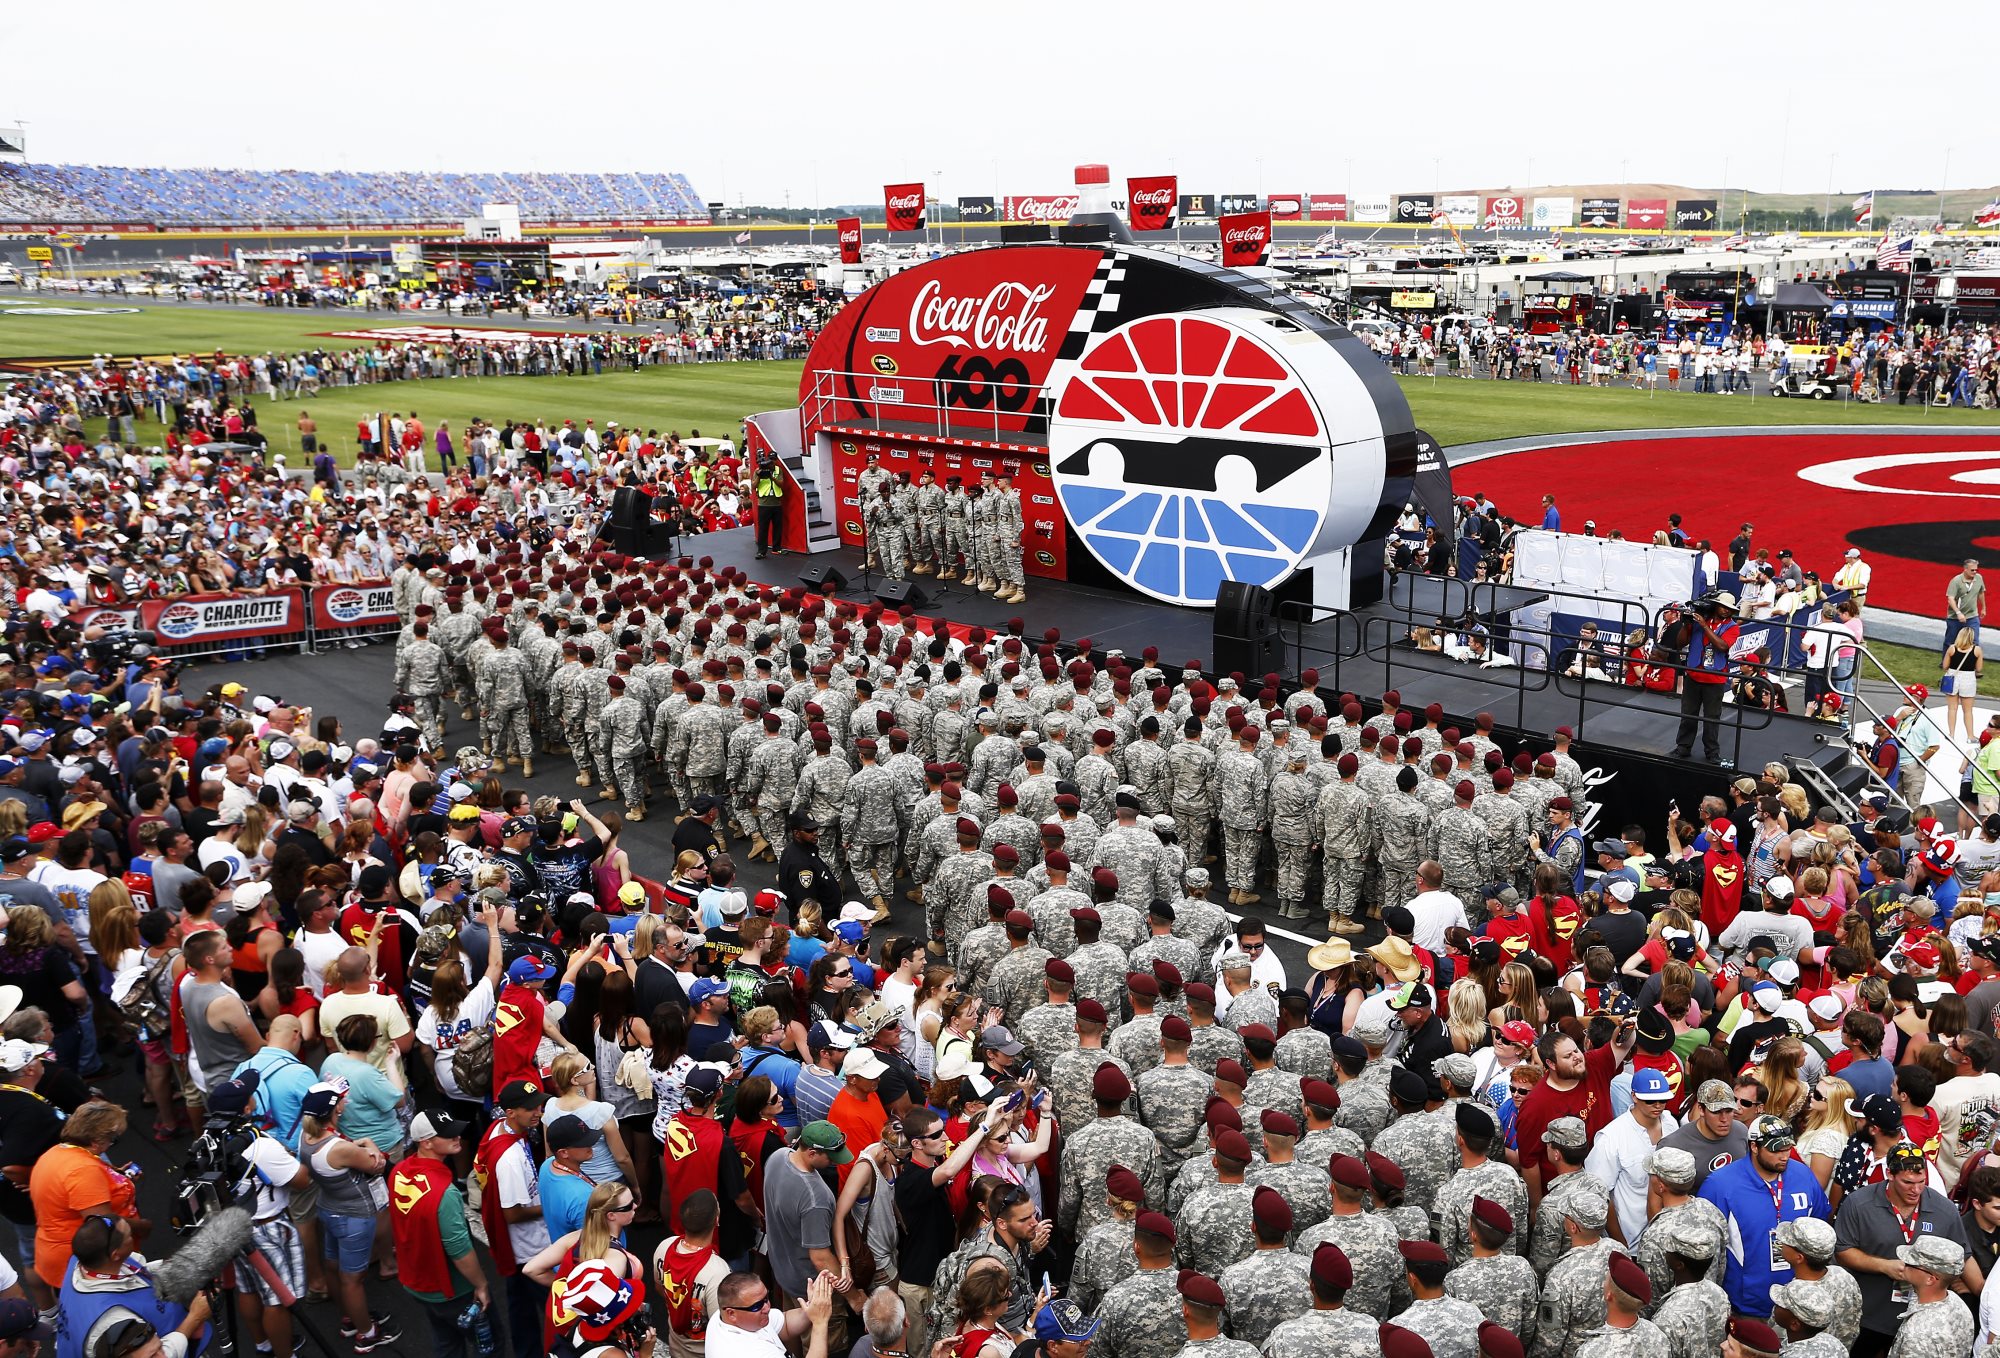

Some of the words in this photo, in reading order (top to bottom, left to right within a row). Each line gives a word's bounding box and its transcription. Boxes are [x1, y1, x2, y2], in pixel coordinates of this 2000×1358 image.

[1134, 189, 1173, 204] Coca-Cola
[960, 205, 982, 215] Sprint
[1018, 197, 1078, 219] Coca-Col
[1140, 205, 1166, 216] 600
[1677, 211, 1701, 222] Sprint
[1225, 225, 1266, 243] Coca-Cola
[1232, 242, 1260, 254] 600
[1962, 288, 1996, 296] HUNGER
[1557, 296, 1570, 309] 95
[1852, 303, 1894, 311] FARMERS
[909, 280, 1056, 352] Coca-Cola
[933, 354, 1031, 411] 600
[1417, 452, 1435, 462] NLY
[203, 601, 283, 622] CHARLOTTE
[205, 620, 236, 628] MOTOR
[238, 616, 282, 625] SPEEDWAY
[1649, 1079, 1661, 1090] D
[1791, 1192, 1808, 1211] D
